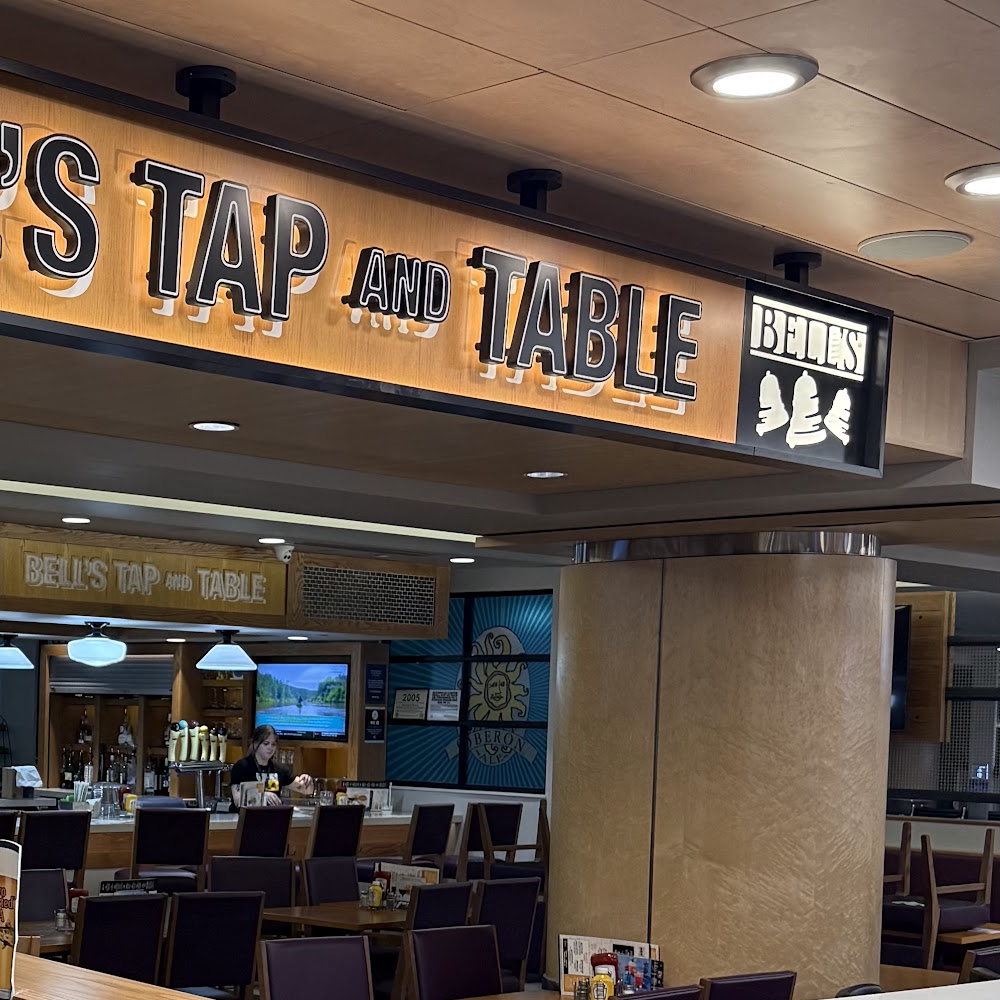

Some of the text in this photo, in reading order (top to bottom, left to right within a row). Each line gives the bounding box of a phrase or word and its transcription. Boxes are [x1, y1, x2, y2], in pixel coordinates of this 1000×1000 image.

[134, 158, 329, 322] TAP
[350, 246, 451, 324] AND
[470, 245, 702, 402] TABLE
[24, 551, 267, 604] BELL'S TAP AND TABLE
[402, 693, 421, 702] 2005
[458, 730, 526, 752] BERON
